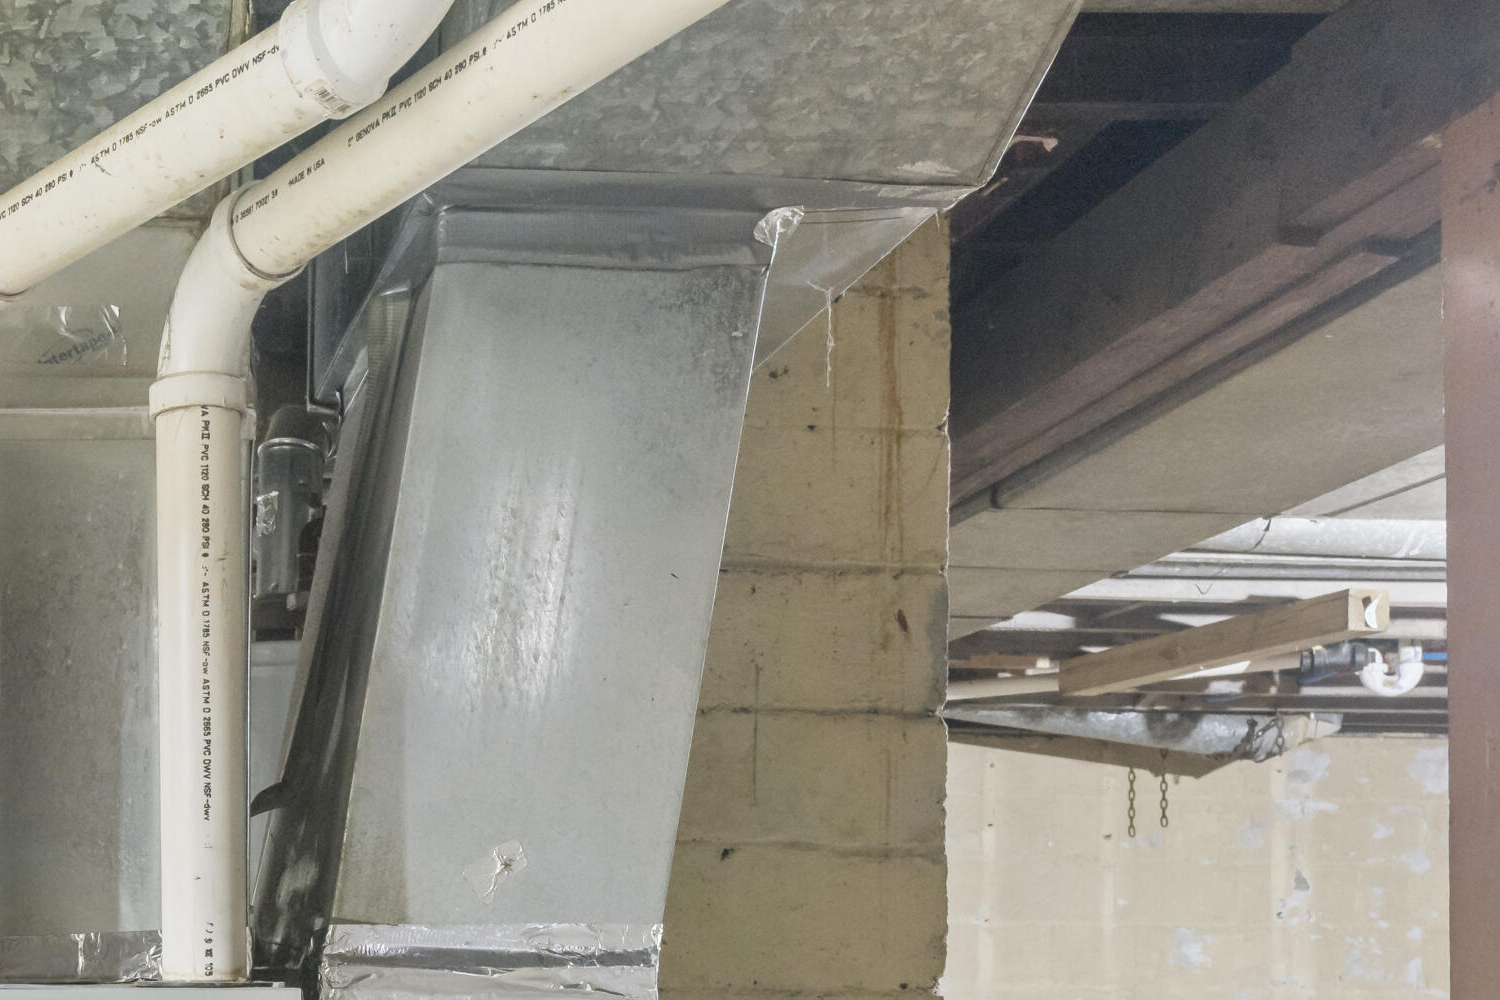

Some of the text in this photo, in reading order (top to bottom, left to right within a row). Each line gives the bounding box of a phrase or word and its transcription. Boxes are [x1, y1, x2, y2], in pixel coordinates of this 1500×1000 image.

[355, 118, 380, 142] GENOVA
[399, 97, 412, 112] PVC
[428, 76, 442, 92] SCH
[444, 69, 452, 81] 40
[506, 18, 528, 40] ASTM
[539, 0, 555, 16] 1785
[21, 192, 33, 206] SCH
[35, 187, 43, 199] 40
[91, 147, 110, 164] ASTM
[119, 132, 134, 147] 1785
[165, 100, 187, 120] ASTM
[196, 82, 213, 100] 2665
[215, 73, 230, 89] PVC
[288, 171, 305, 186] MADE
[313, 157, 325, 172] USA
[201, 444, 209, 461] PVC
[200, 464, 209, 481] 1120
[201, 484, 210, 501] SCH
[201, 504, 210, 515] 40
[201, 518, 210, 533] 280
[201, 536, 210, 550] PSI
[202, 581, 210, 607] ASTM
[202, 620, 210, 638] 1785
[202, 678, 210, 704] ASTM
[203, 716, 211, 737] 2665
[203, 739, 211, 756] PVC
[203, 782, 212, 821] NSF-dwv
